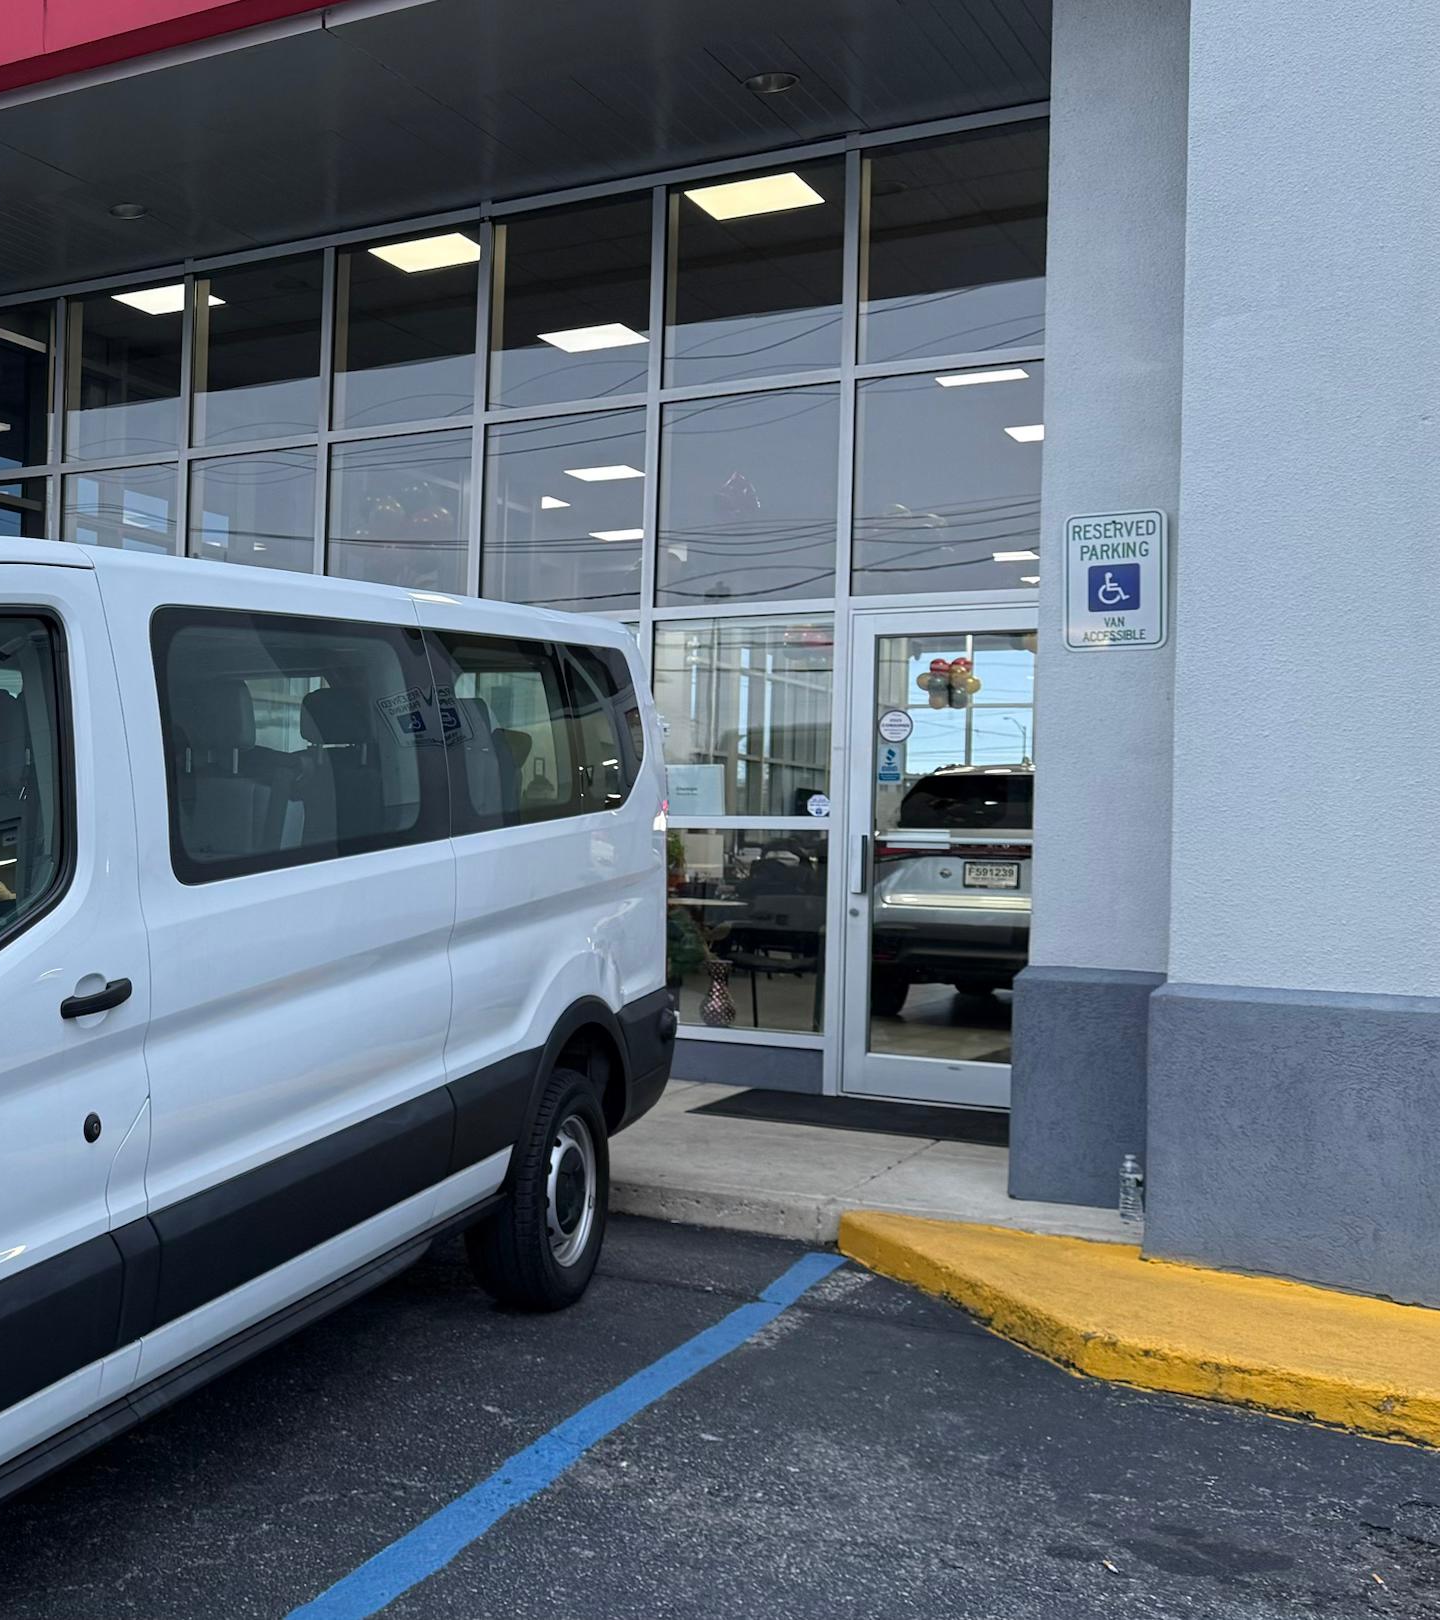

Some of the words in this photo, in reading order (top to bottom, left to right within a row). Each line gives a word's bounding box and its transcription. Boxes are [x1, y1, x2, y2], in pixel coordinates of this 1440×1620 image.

[1072, 519, 1157, 541] RESERVED
[1080, 541, 1150, 561] PARKING
[1104, 616, 1125, 628] VAN
[1082, 629, 1146, 642] ACCESSIBLE
